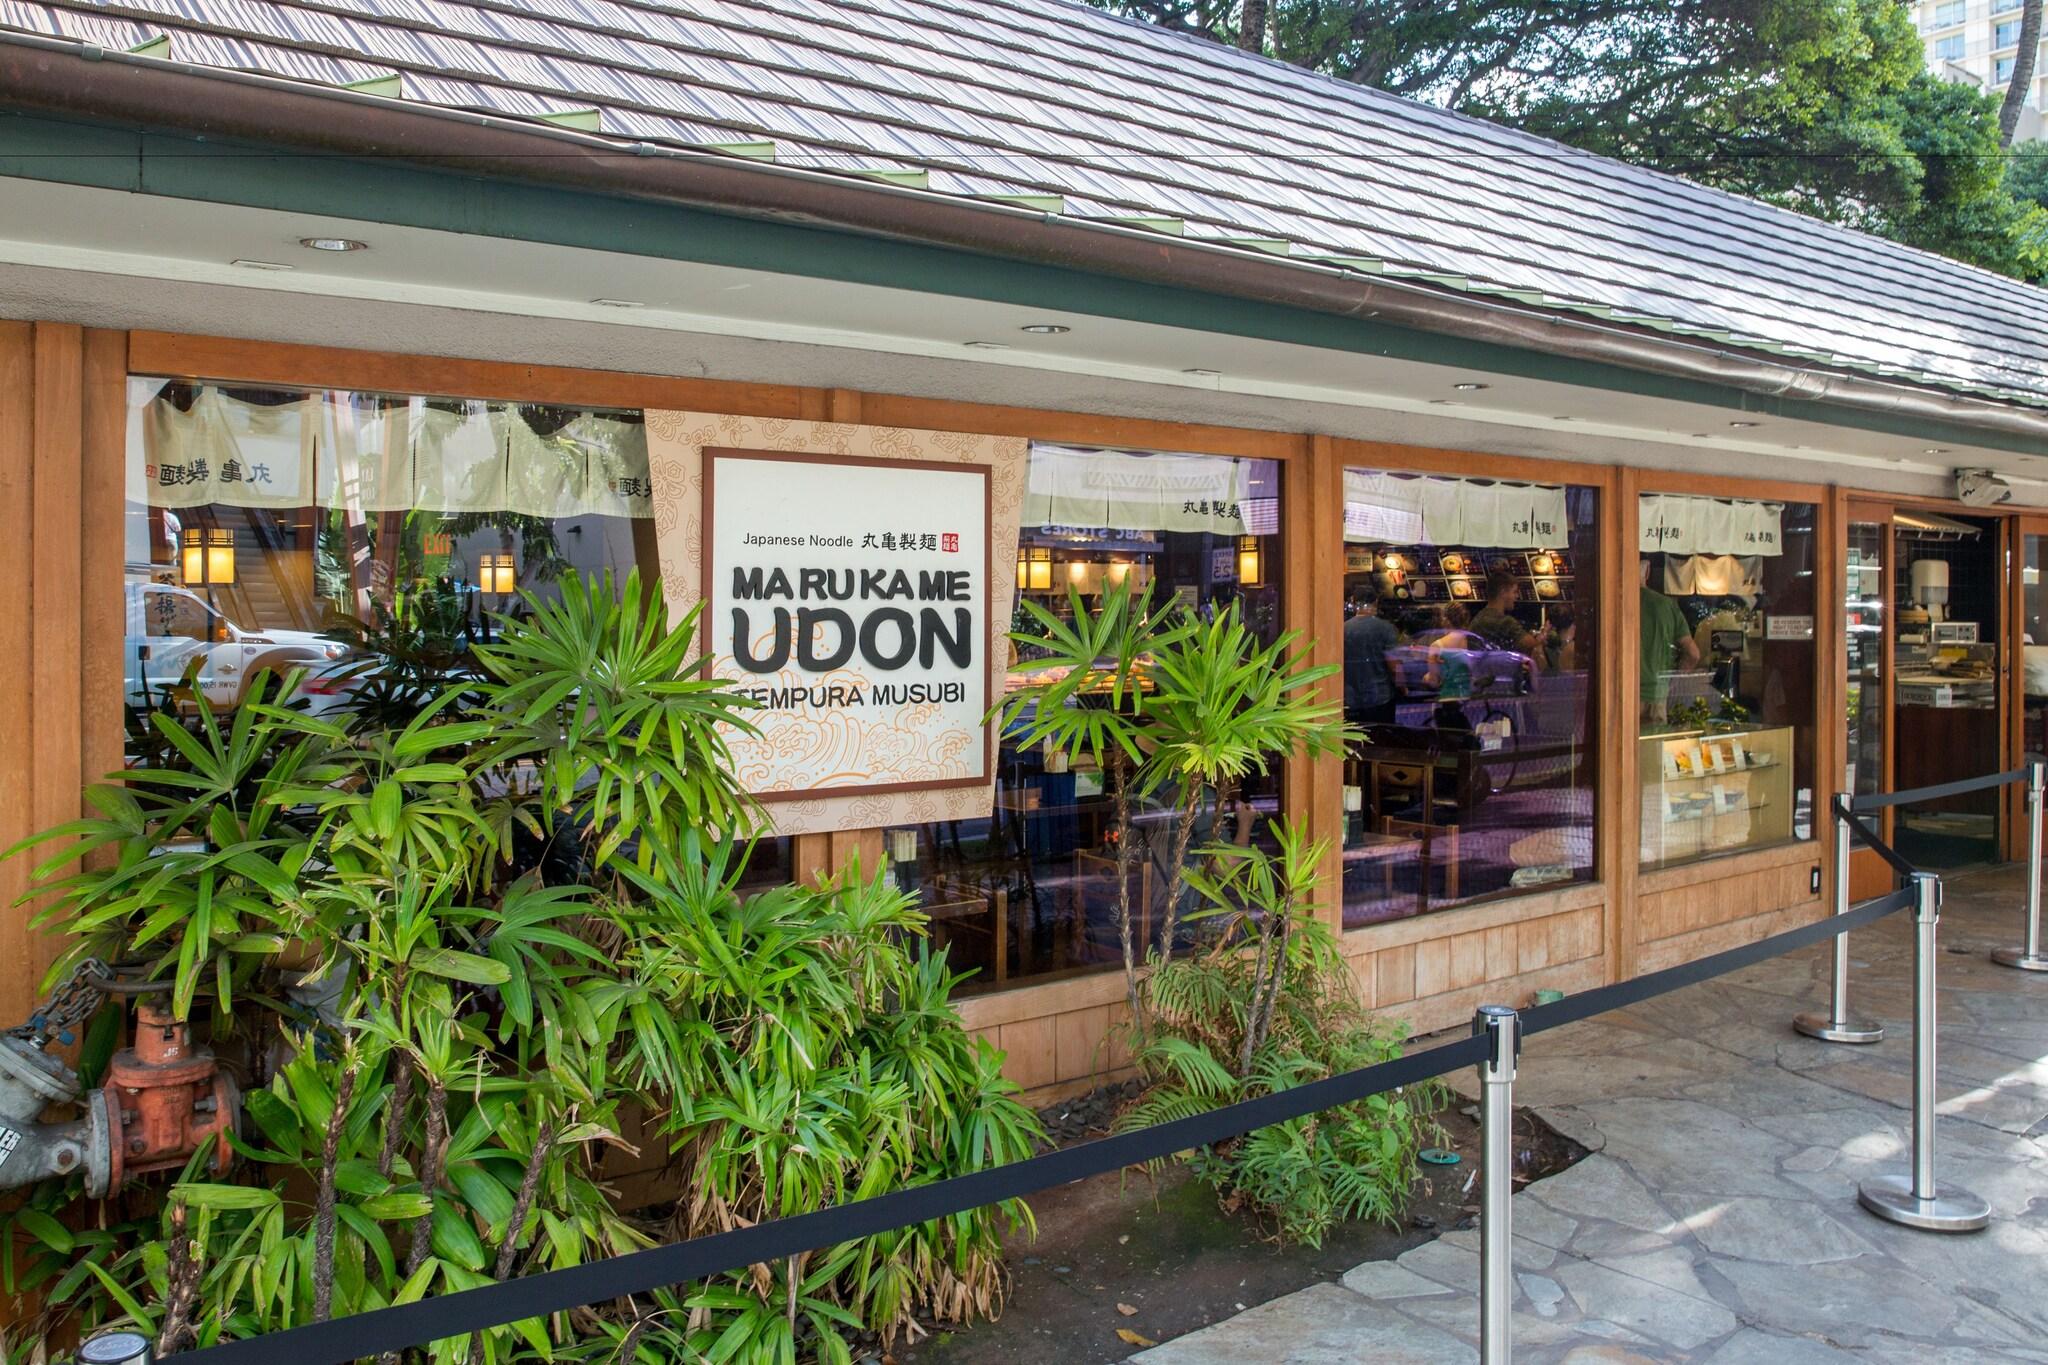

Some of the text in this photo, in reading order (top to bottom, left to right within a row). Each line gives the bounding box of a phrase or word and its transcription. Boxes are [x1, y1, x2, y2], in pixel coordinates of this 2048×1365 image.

[743, 532, 854, 548] Japanese Noodle
[860, 531, 937, 551] 丸亀製麺
[732, 566, 972, 601] MARUKAME
[731, 606, 972, 674] UDON
[872, 682, 966, 706] MUSUBI
